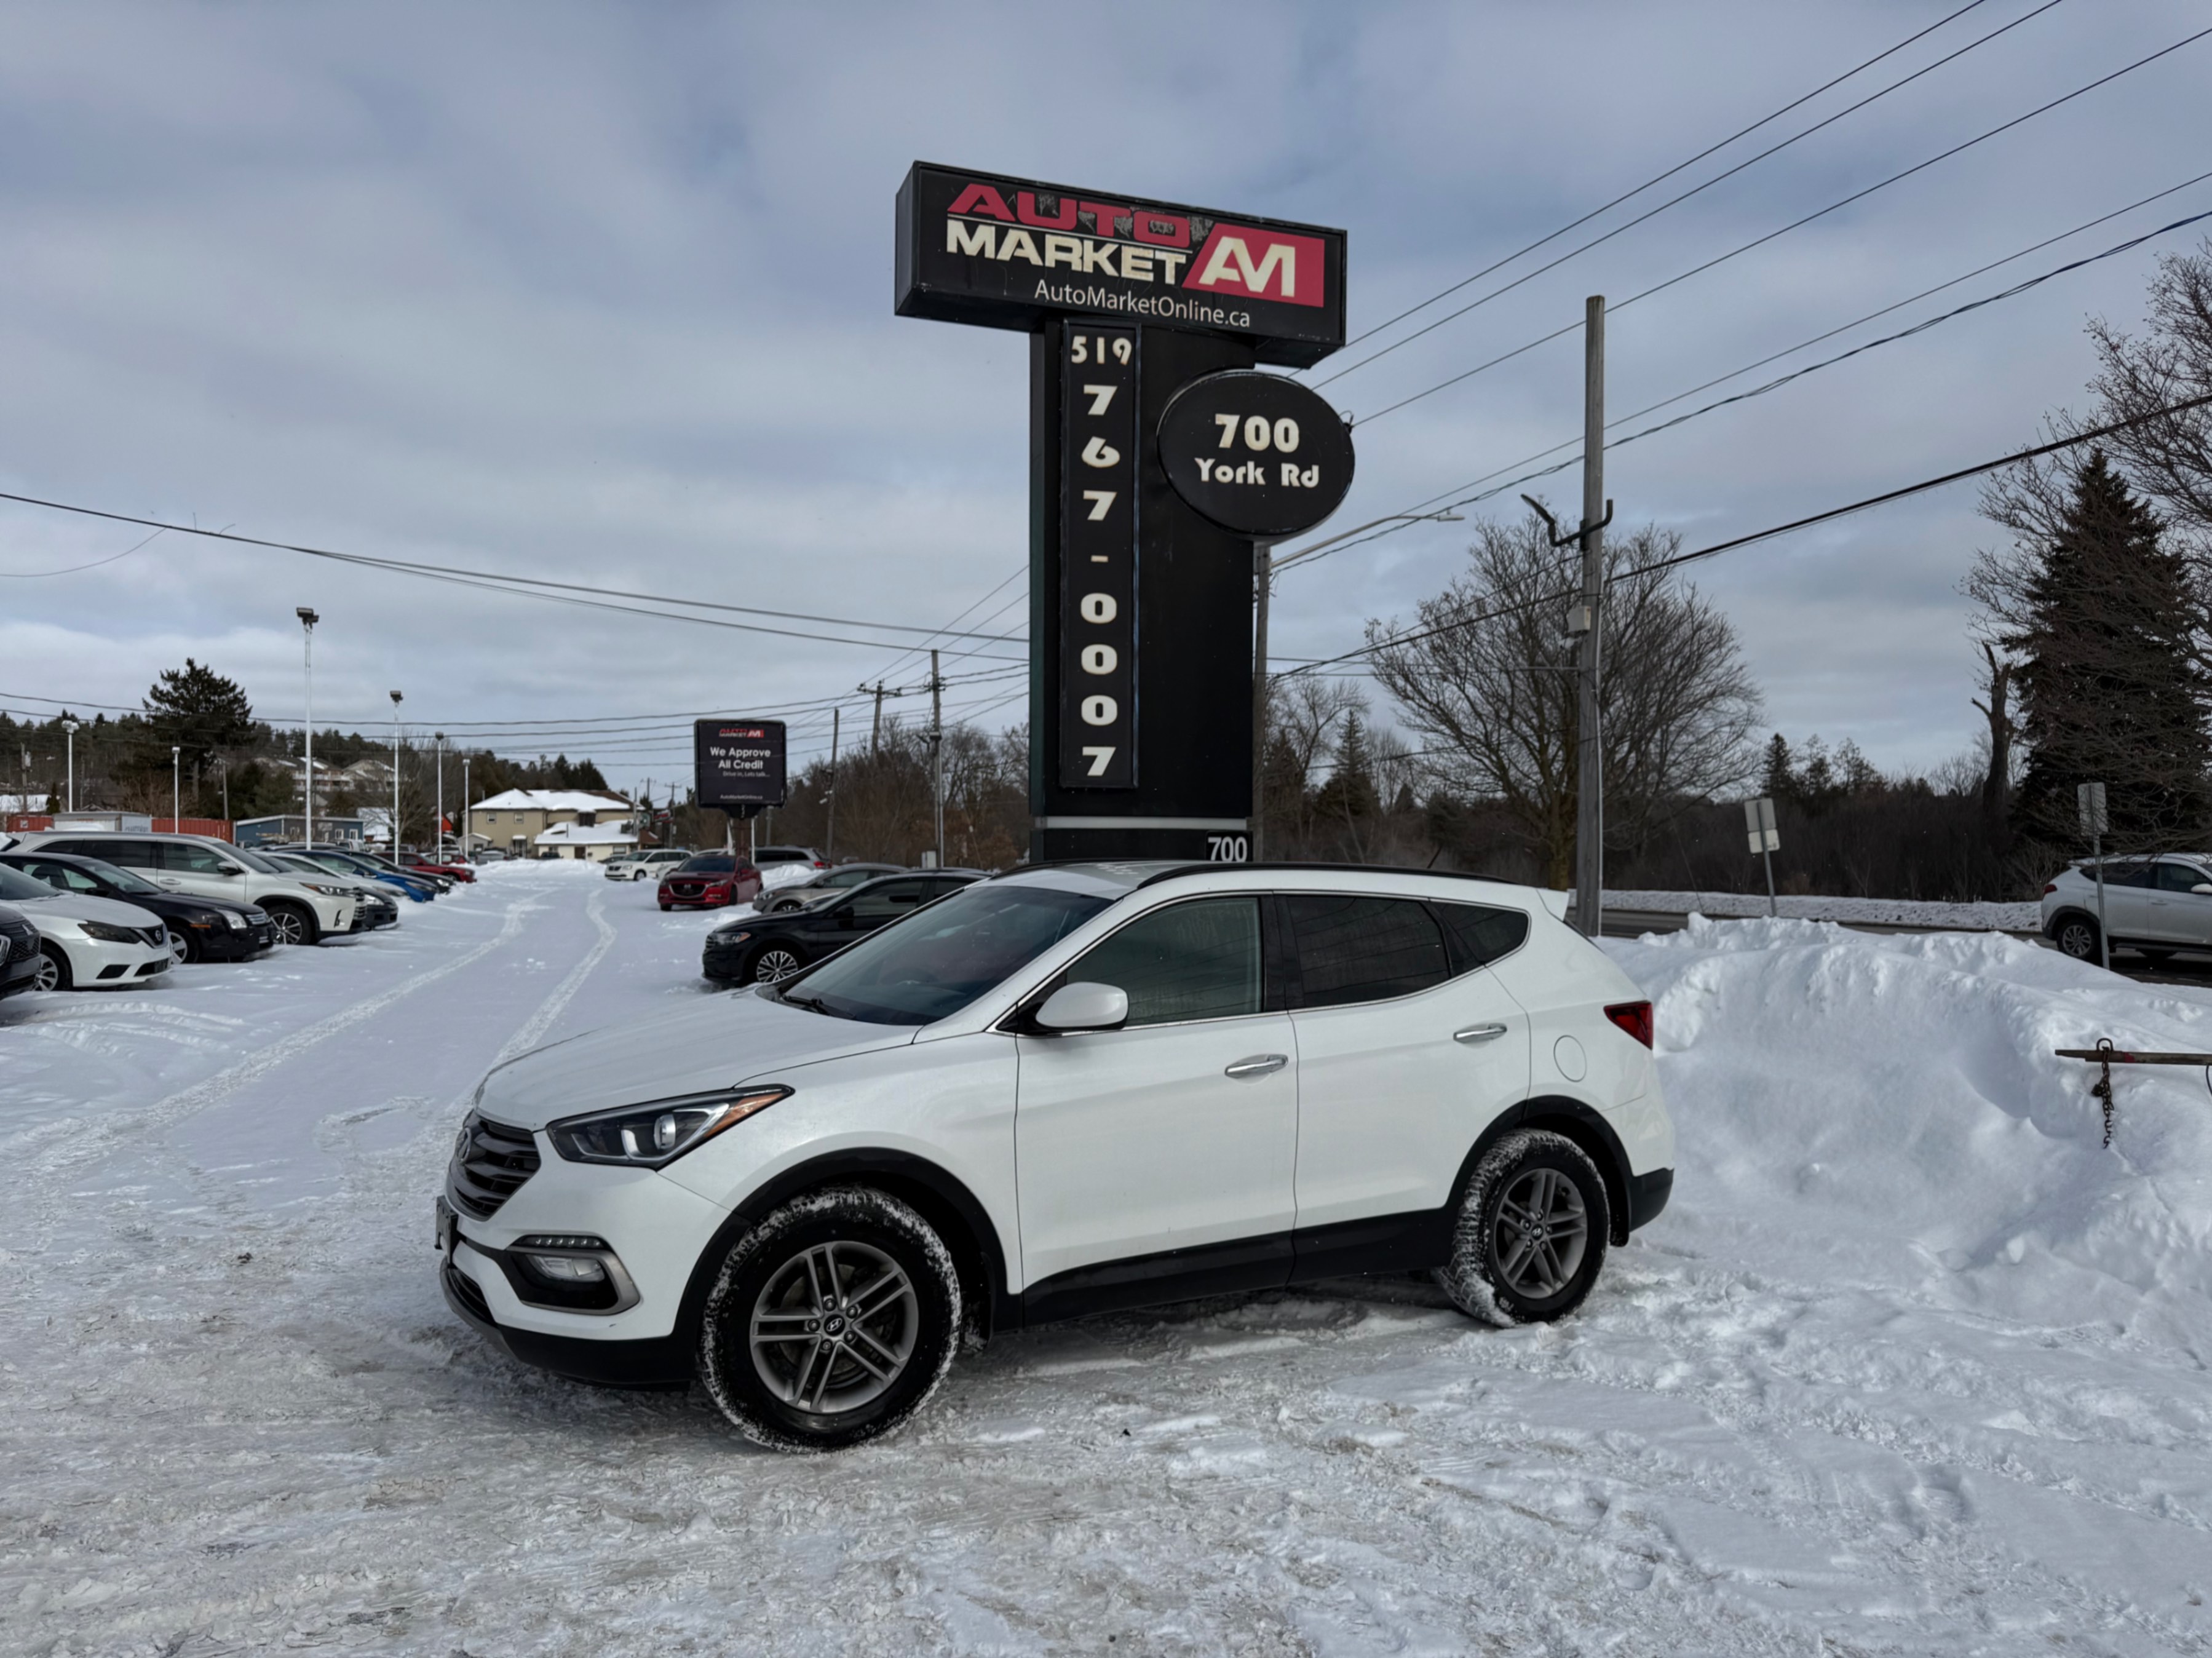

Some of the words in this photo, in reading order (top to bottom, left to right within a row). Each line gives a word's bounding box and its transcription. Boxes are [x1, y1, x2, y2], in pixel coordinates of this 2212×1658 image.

[947, 183, 1190, 247] AUTO
[947, 220, 1187, 285] MARKET
[1034, 279, 1251, 328] AutoMarketOnline.ca
[1071, 335, 1132, 365] 519
[1215, 413, 1300, 453] 700
[1194, 458, 1266, 485] York
[1281, 463, 1320, 488] Rd
[710, 747, 726, 756] We
[729, 747, 771, 758] Approve
[718, 760, 731, 769] All
[733, 760, 763, 769] Credit
[1208, 836, 1247, 862] 700
